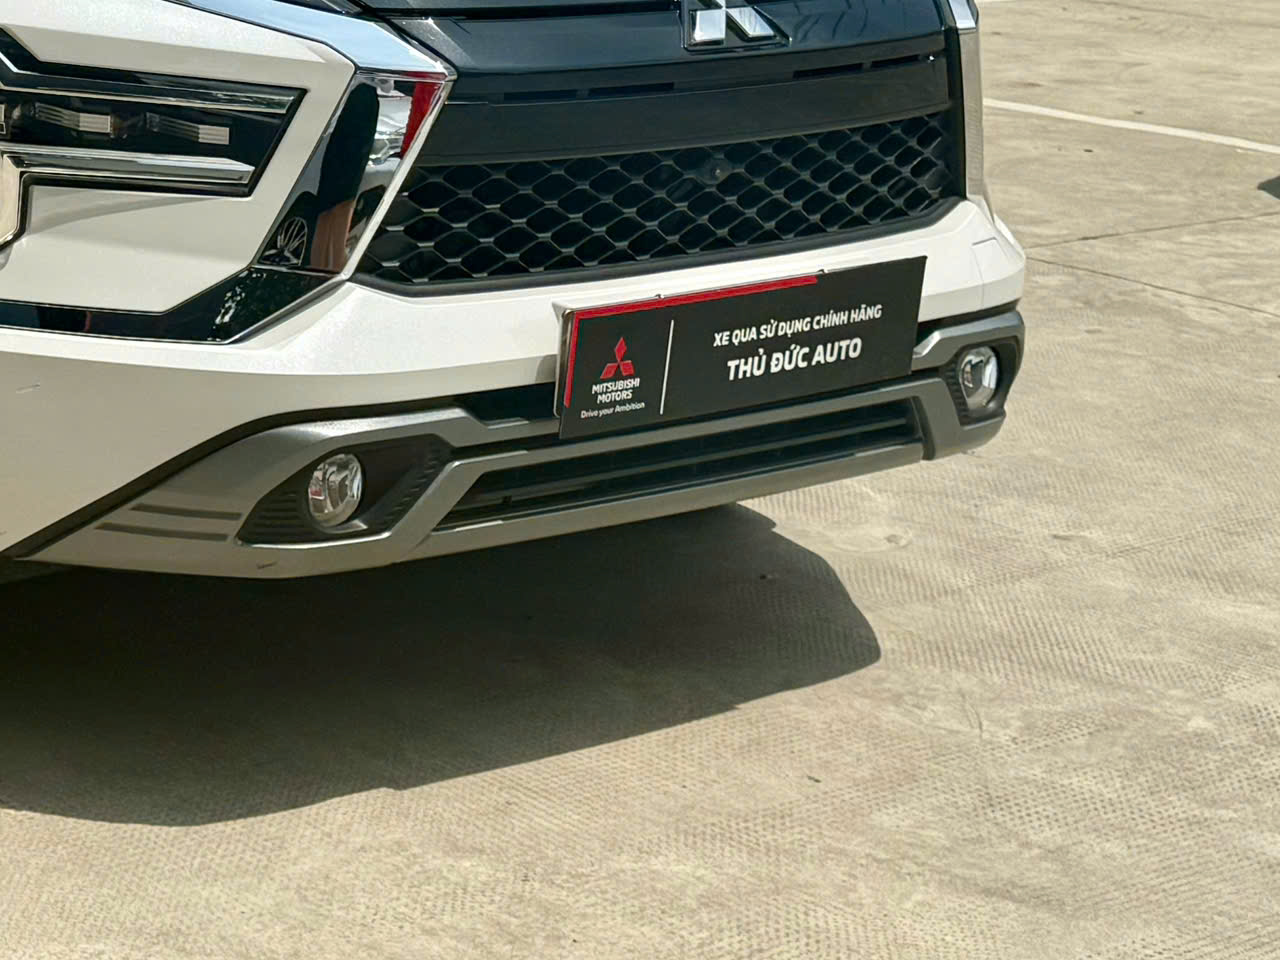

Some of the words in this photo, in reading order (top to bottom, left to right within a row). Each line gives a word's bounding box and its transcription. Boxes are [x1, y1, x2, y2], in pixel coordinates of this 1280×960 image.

[712, 331, 730, 347] XE
[732, 327, 757, 345] QUA
[759, 319, 778, 339] SỬ
[777, 316, 811, 338] DỤNG
[812, 309, 849, 329] CHÍNH
[849, 304, 883, 324] HÃNG
[727, 348, 767, 381] THỦ
[769, 343, 810, 374] ĐỨC
[811, 337, 863, 366] AUTO
[591, 377, 640, 394] MITSUBISHI
[596, 390, 633, 404] MOTORS
[580, 408, 598, 419] Drive
[599, 407, 614, 417] your
[614, 401, 646, 413] Ambition
